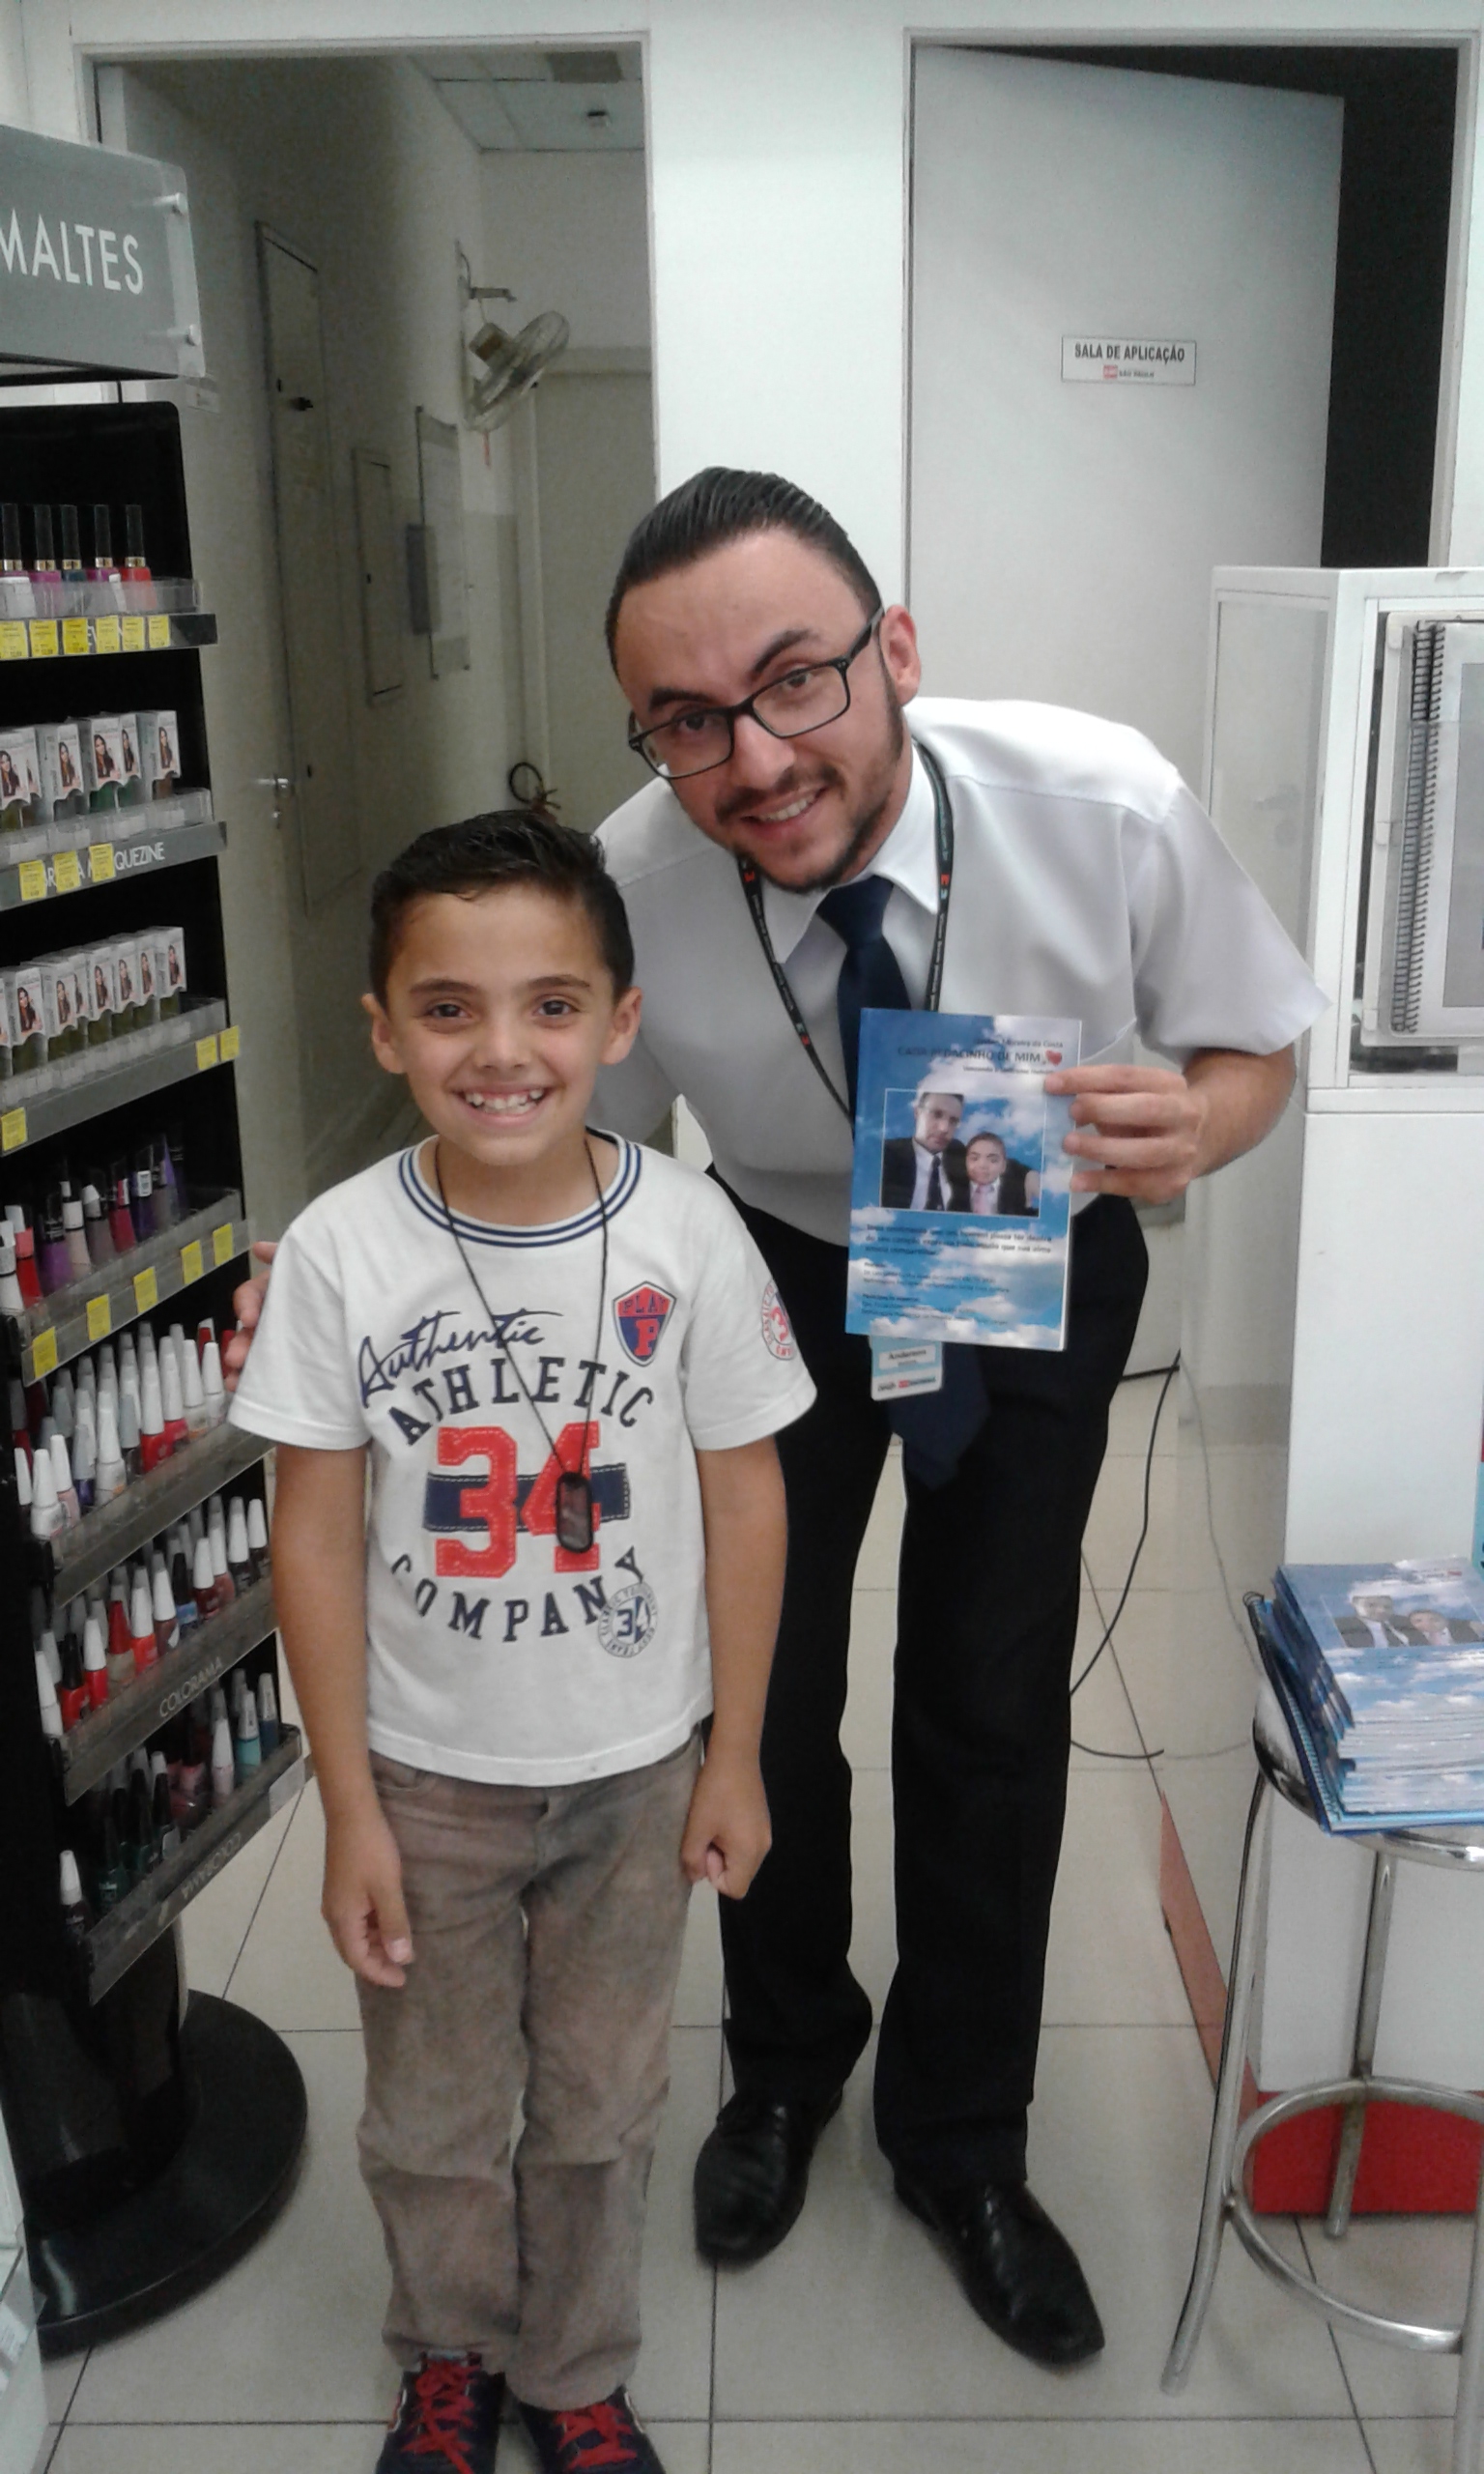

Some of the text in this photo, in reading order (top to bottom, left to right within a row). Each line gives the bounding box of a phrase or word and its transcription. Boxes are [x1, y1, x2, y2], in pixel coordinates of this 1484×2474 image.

[1074, 342, 1185, 365] SALA DE APLICAÇÃO
[1014, 1051, 1042, 1063] MIM
[622, 1293, 667, 1314] PLAY
[359, 1308, 564, 1408] Authentic
[634, 1318, 661, 1357] P
[388, 1356, 655, 1446] ATHLETIC
[436, 1420, 601, 1579] 34
[390, 1546, 645, 1642] COMPANY
[159, 1655, 223, 1717] COLORAMA
